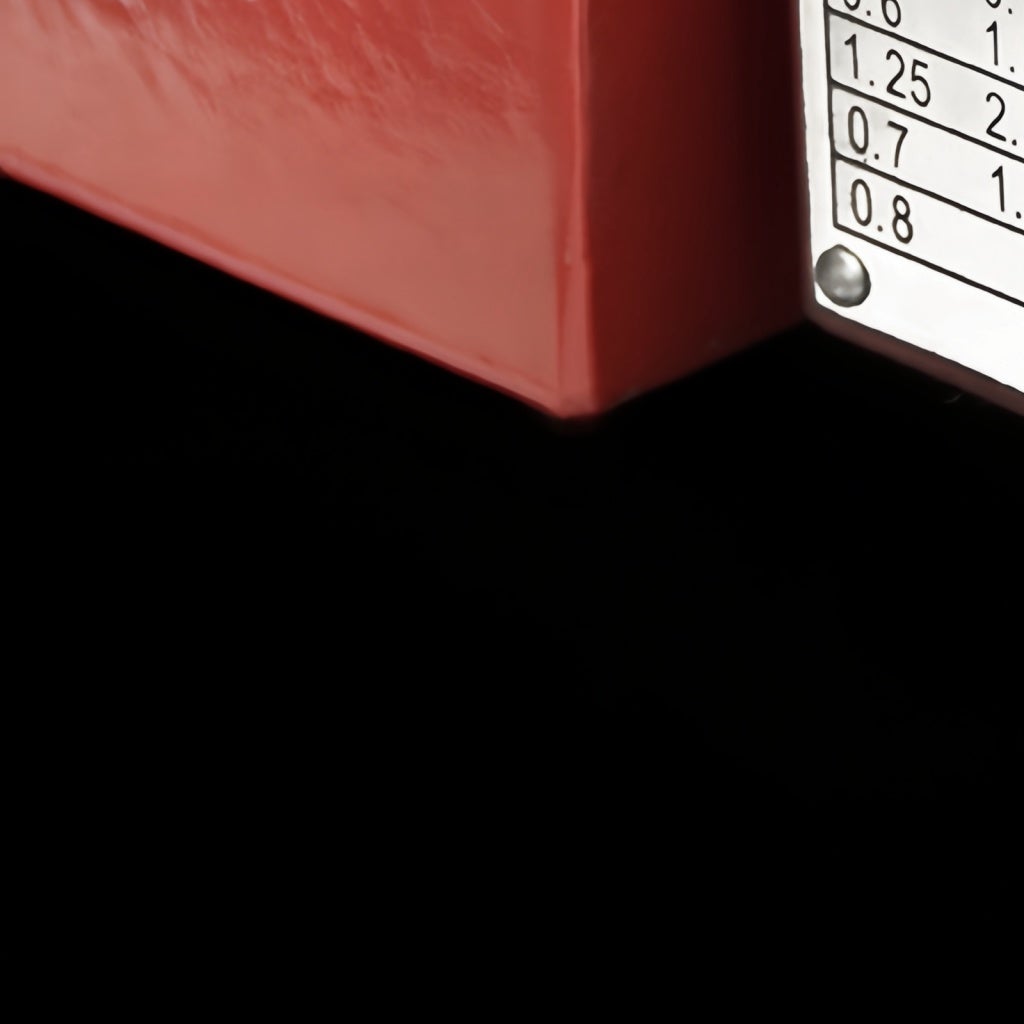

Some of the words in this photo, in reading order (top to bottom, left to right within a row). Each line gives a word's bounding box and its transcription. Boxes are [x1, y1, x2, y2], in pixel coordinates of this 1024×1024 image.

[843, 34, 932, 108] 1.25
[847, 105, 909, 169] 0.7
[850, 178, 914, 245] 0.8
